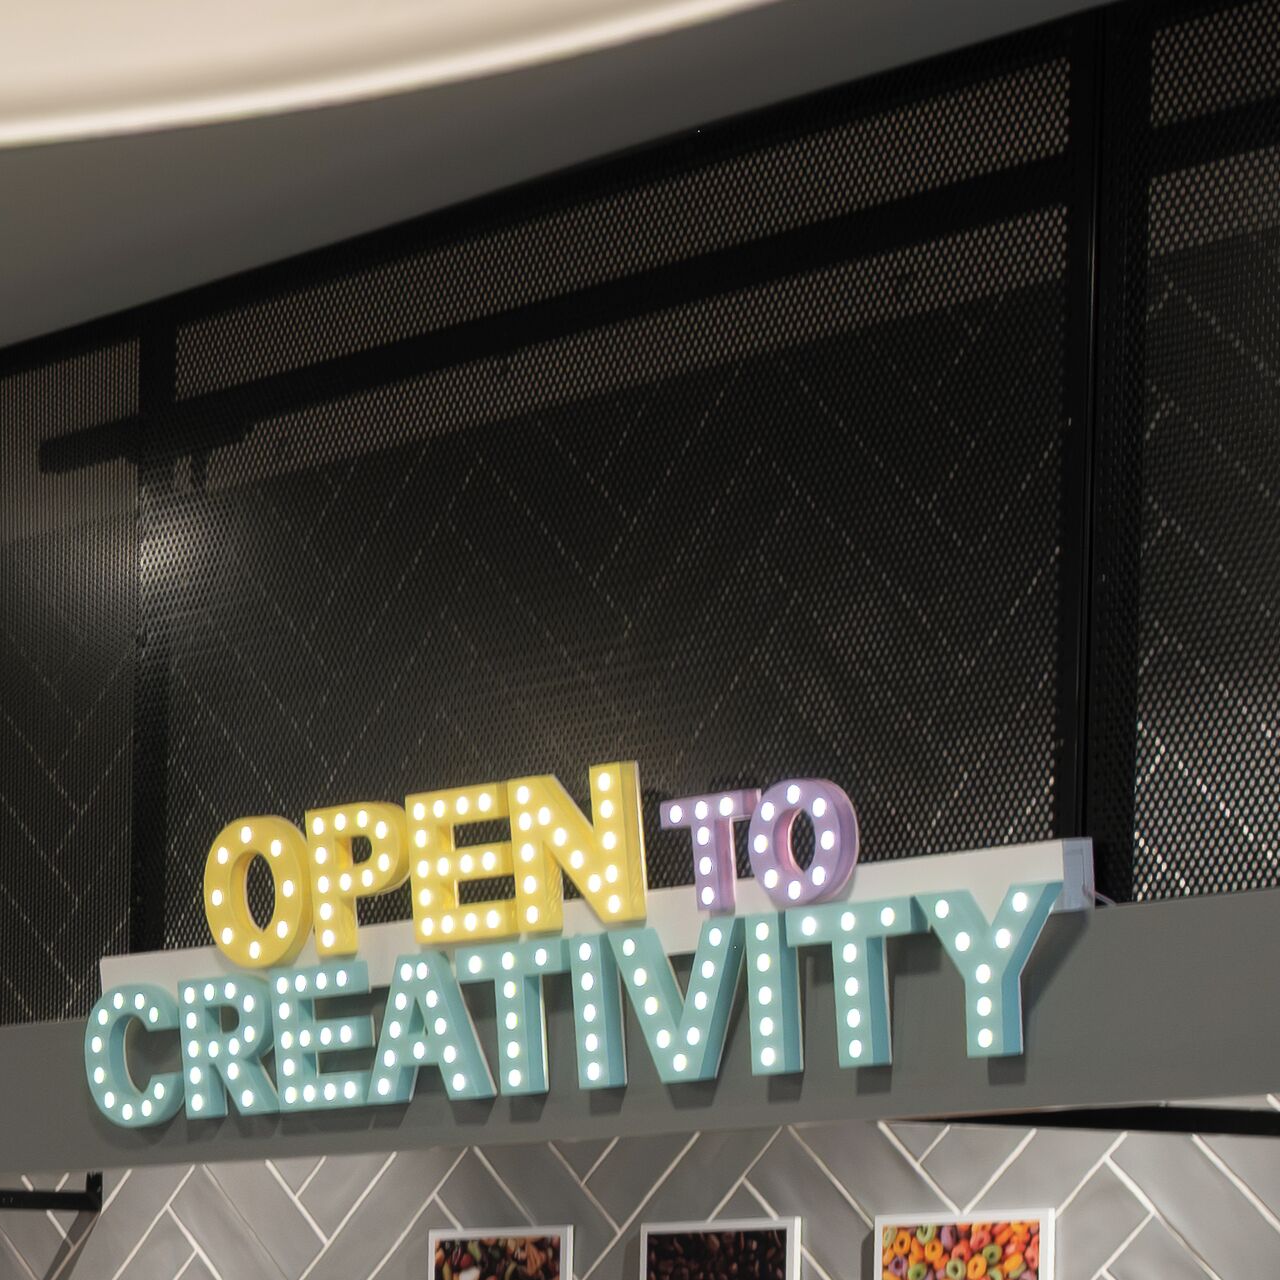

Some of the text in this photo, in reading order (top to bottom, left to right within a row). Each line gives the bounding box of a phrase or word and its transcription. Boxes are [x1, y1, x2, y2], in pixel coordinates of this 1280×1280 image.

[203, 761, 858, 969] OPEN TO
[83, 882, 1064, 1128] CREATIVITY
